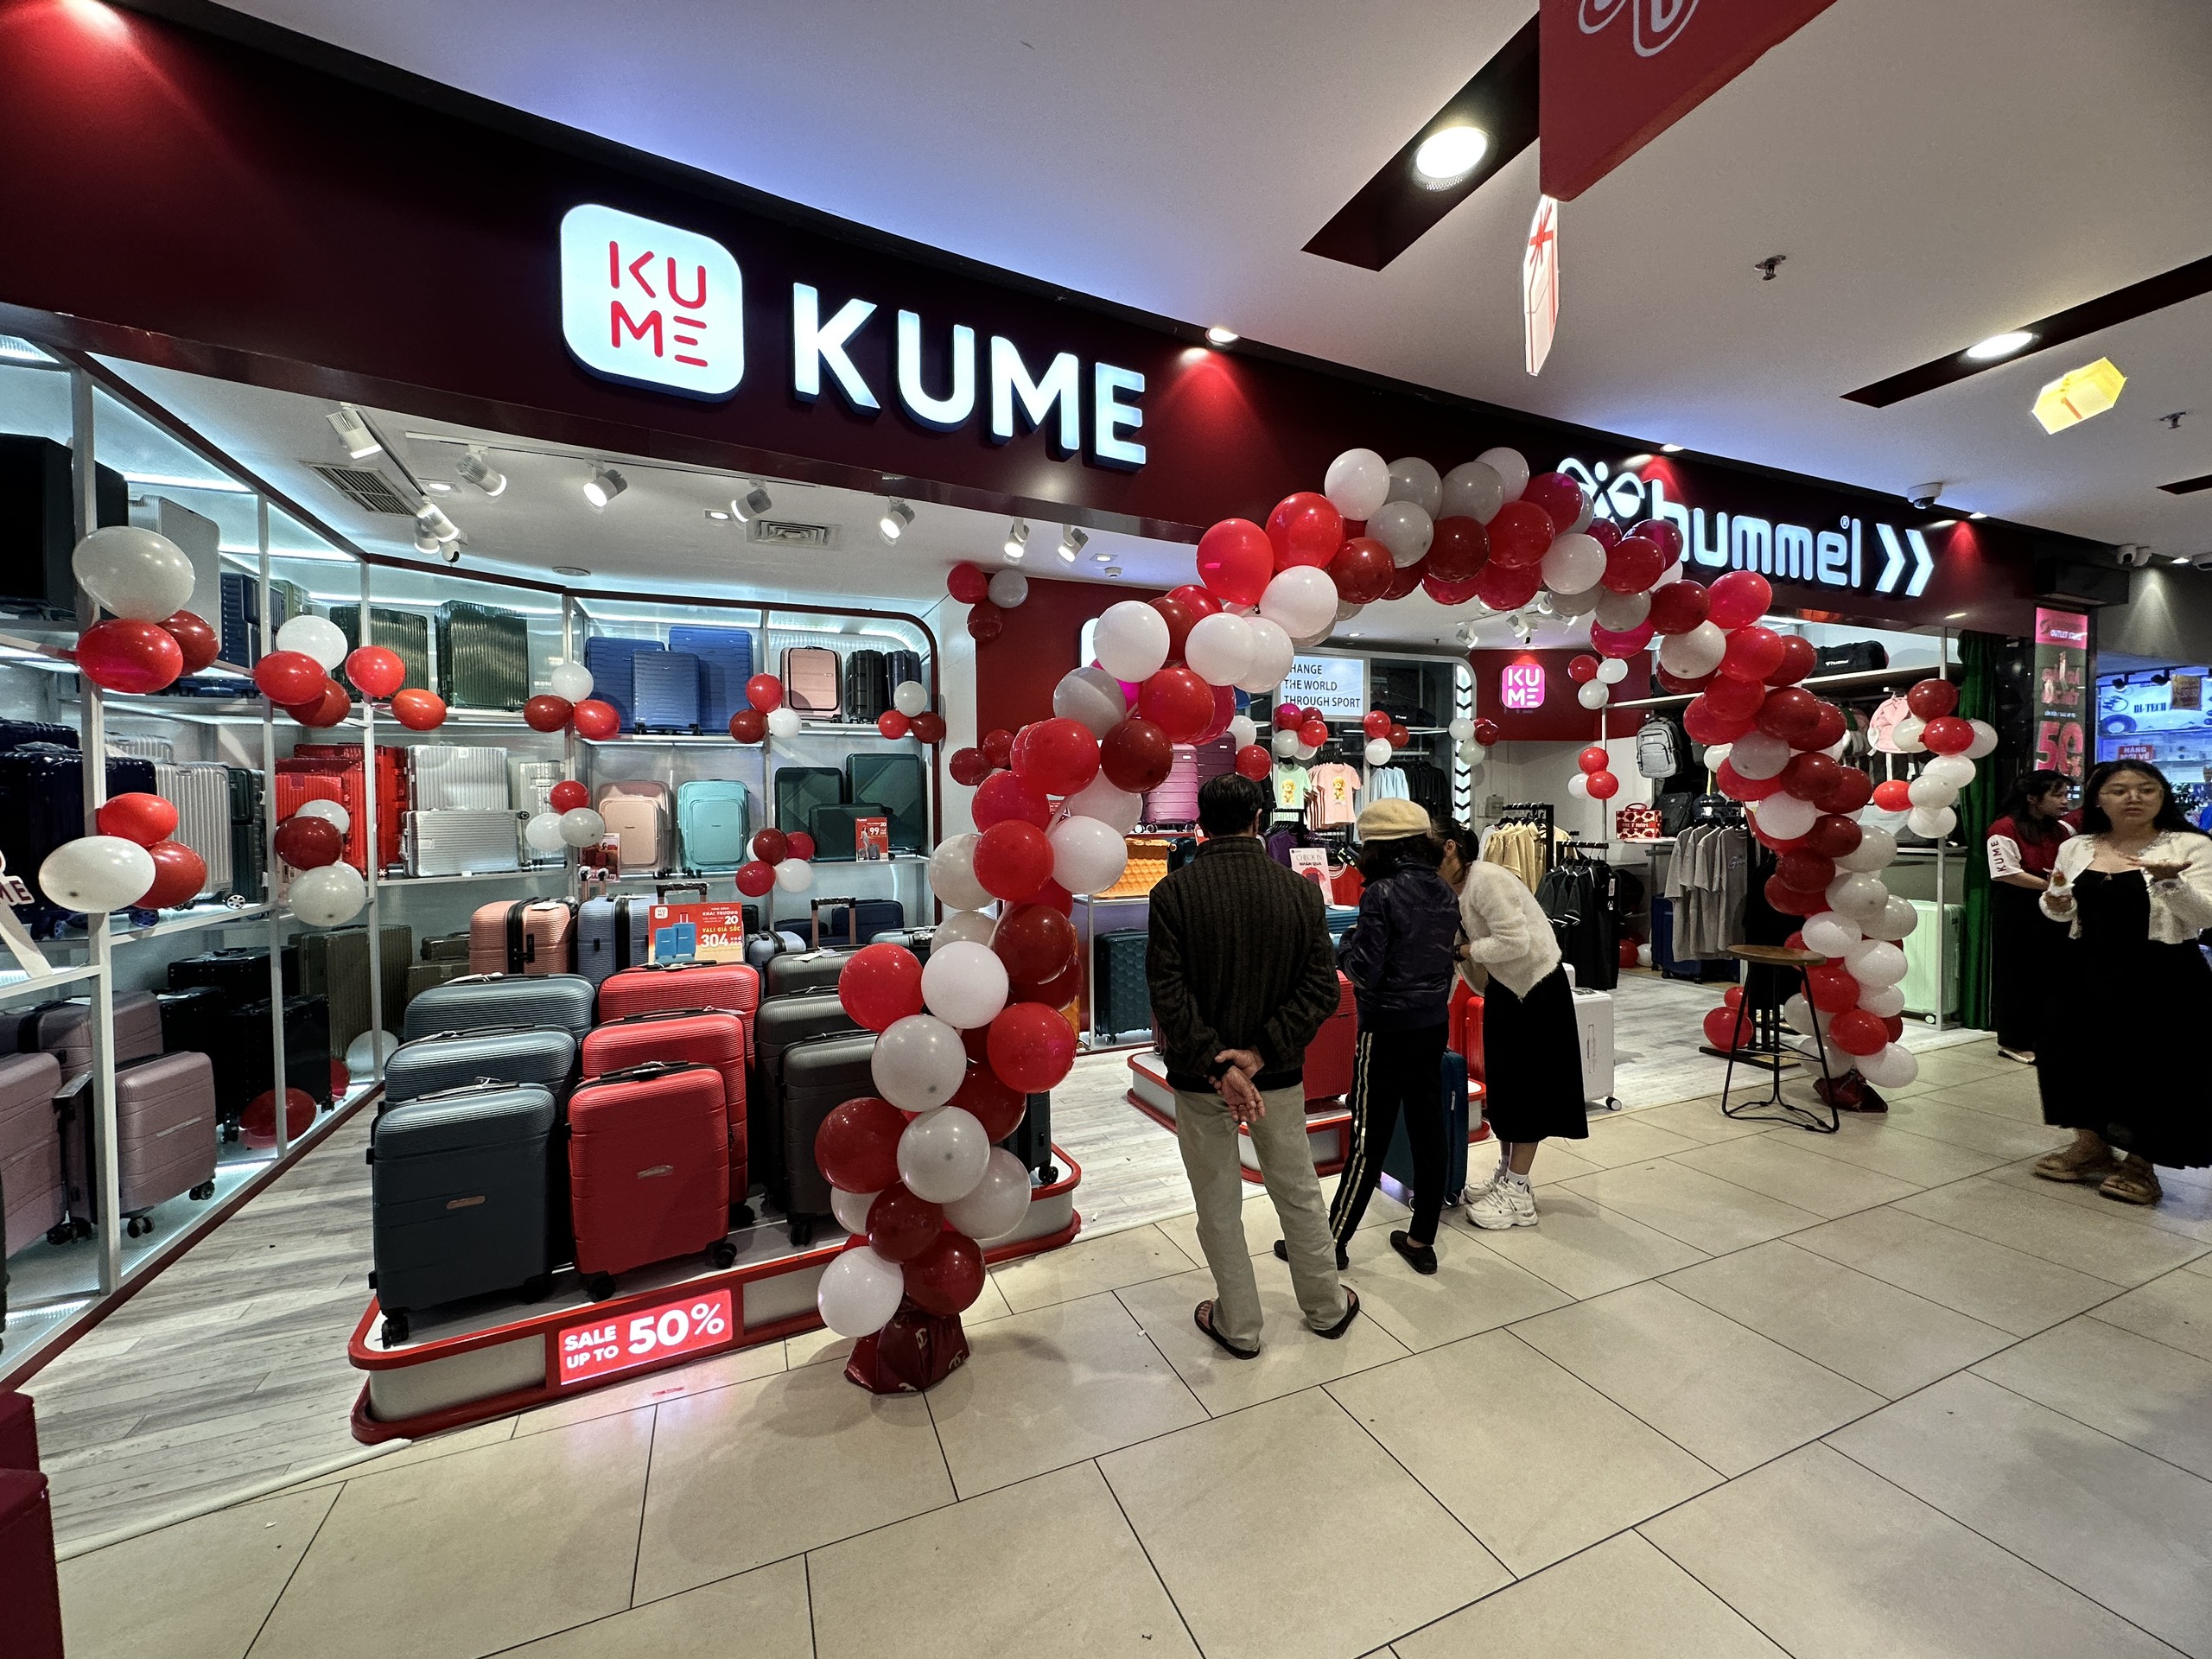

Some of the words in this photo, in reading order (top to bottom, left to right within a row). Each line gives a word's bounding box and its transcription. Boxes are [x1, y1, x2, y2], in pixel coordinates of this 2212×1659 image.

[608, 240, 707, 309] KU
[610, 299, 709, 367] ME
[792, 282, 1147, 466] KUME
[1651, 478, 1861, 588] hummel
[1290, 664, 1323, 675] HANGE
[1508, 668, 1540, 687] KU
[1284, 679, 1302, 690] THE
[1303, 680, 1338, 691] WORLD
[1507, 688, 1540, 706] ME
[1284, 696, 1330, 707] THROUGH
[1332, 697, 1361, 708] SPORT
[1990, 841, 2007, 873] KUME
[724, 915, 739, 925] 20
[701, 933, 728, 948] 304
[564, 1325, 617, 1351] SALE
[628, 1303, 725, 1354] 50%
[566, 1351, 591, 1369] UP
[593, 1345, 620, 1362] TO
